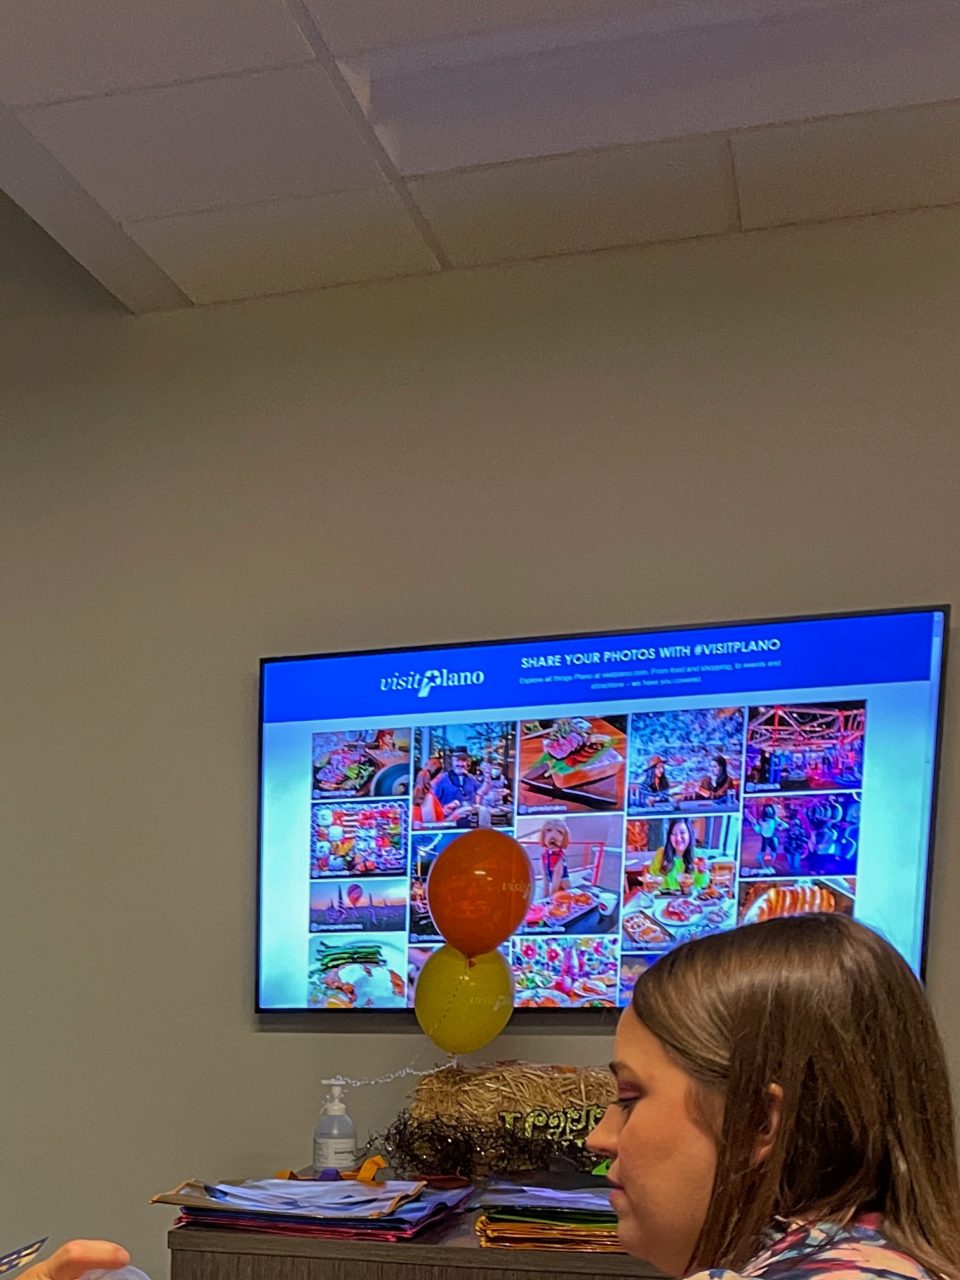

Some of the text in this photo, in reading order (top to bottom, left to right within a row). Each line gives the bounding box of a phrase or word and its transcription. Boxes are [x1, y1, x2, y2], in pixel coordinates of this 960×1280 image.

[521, 638, 780, 669] SHARE YOUR PHOTOS WITH #VISITPLANO
